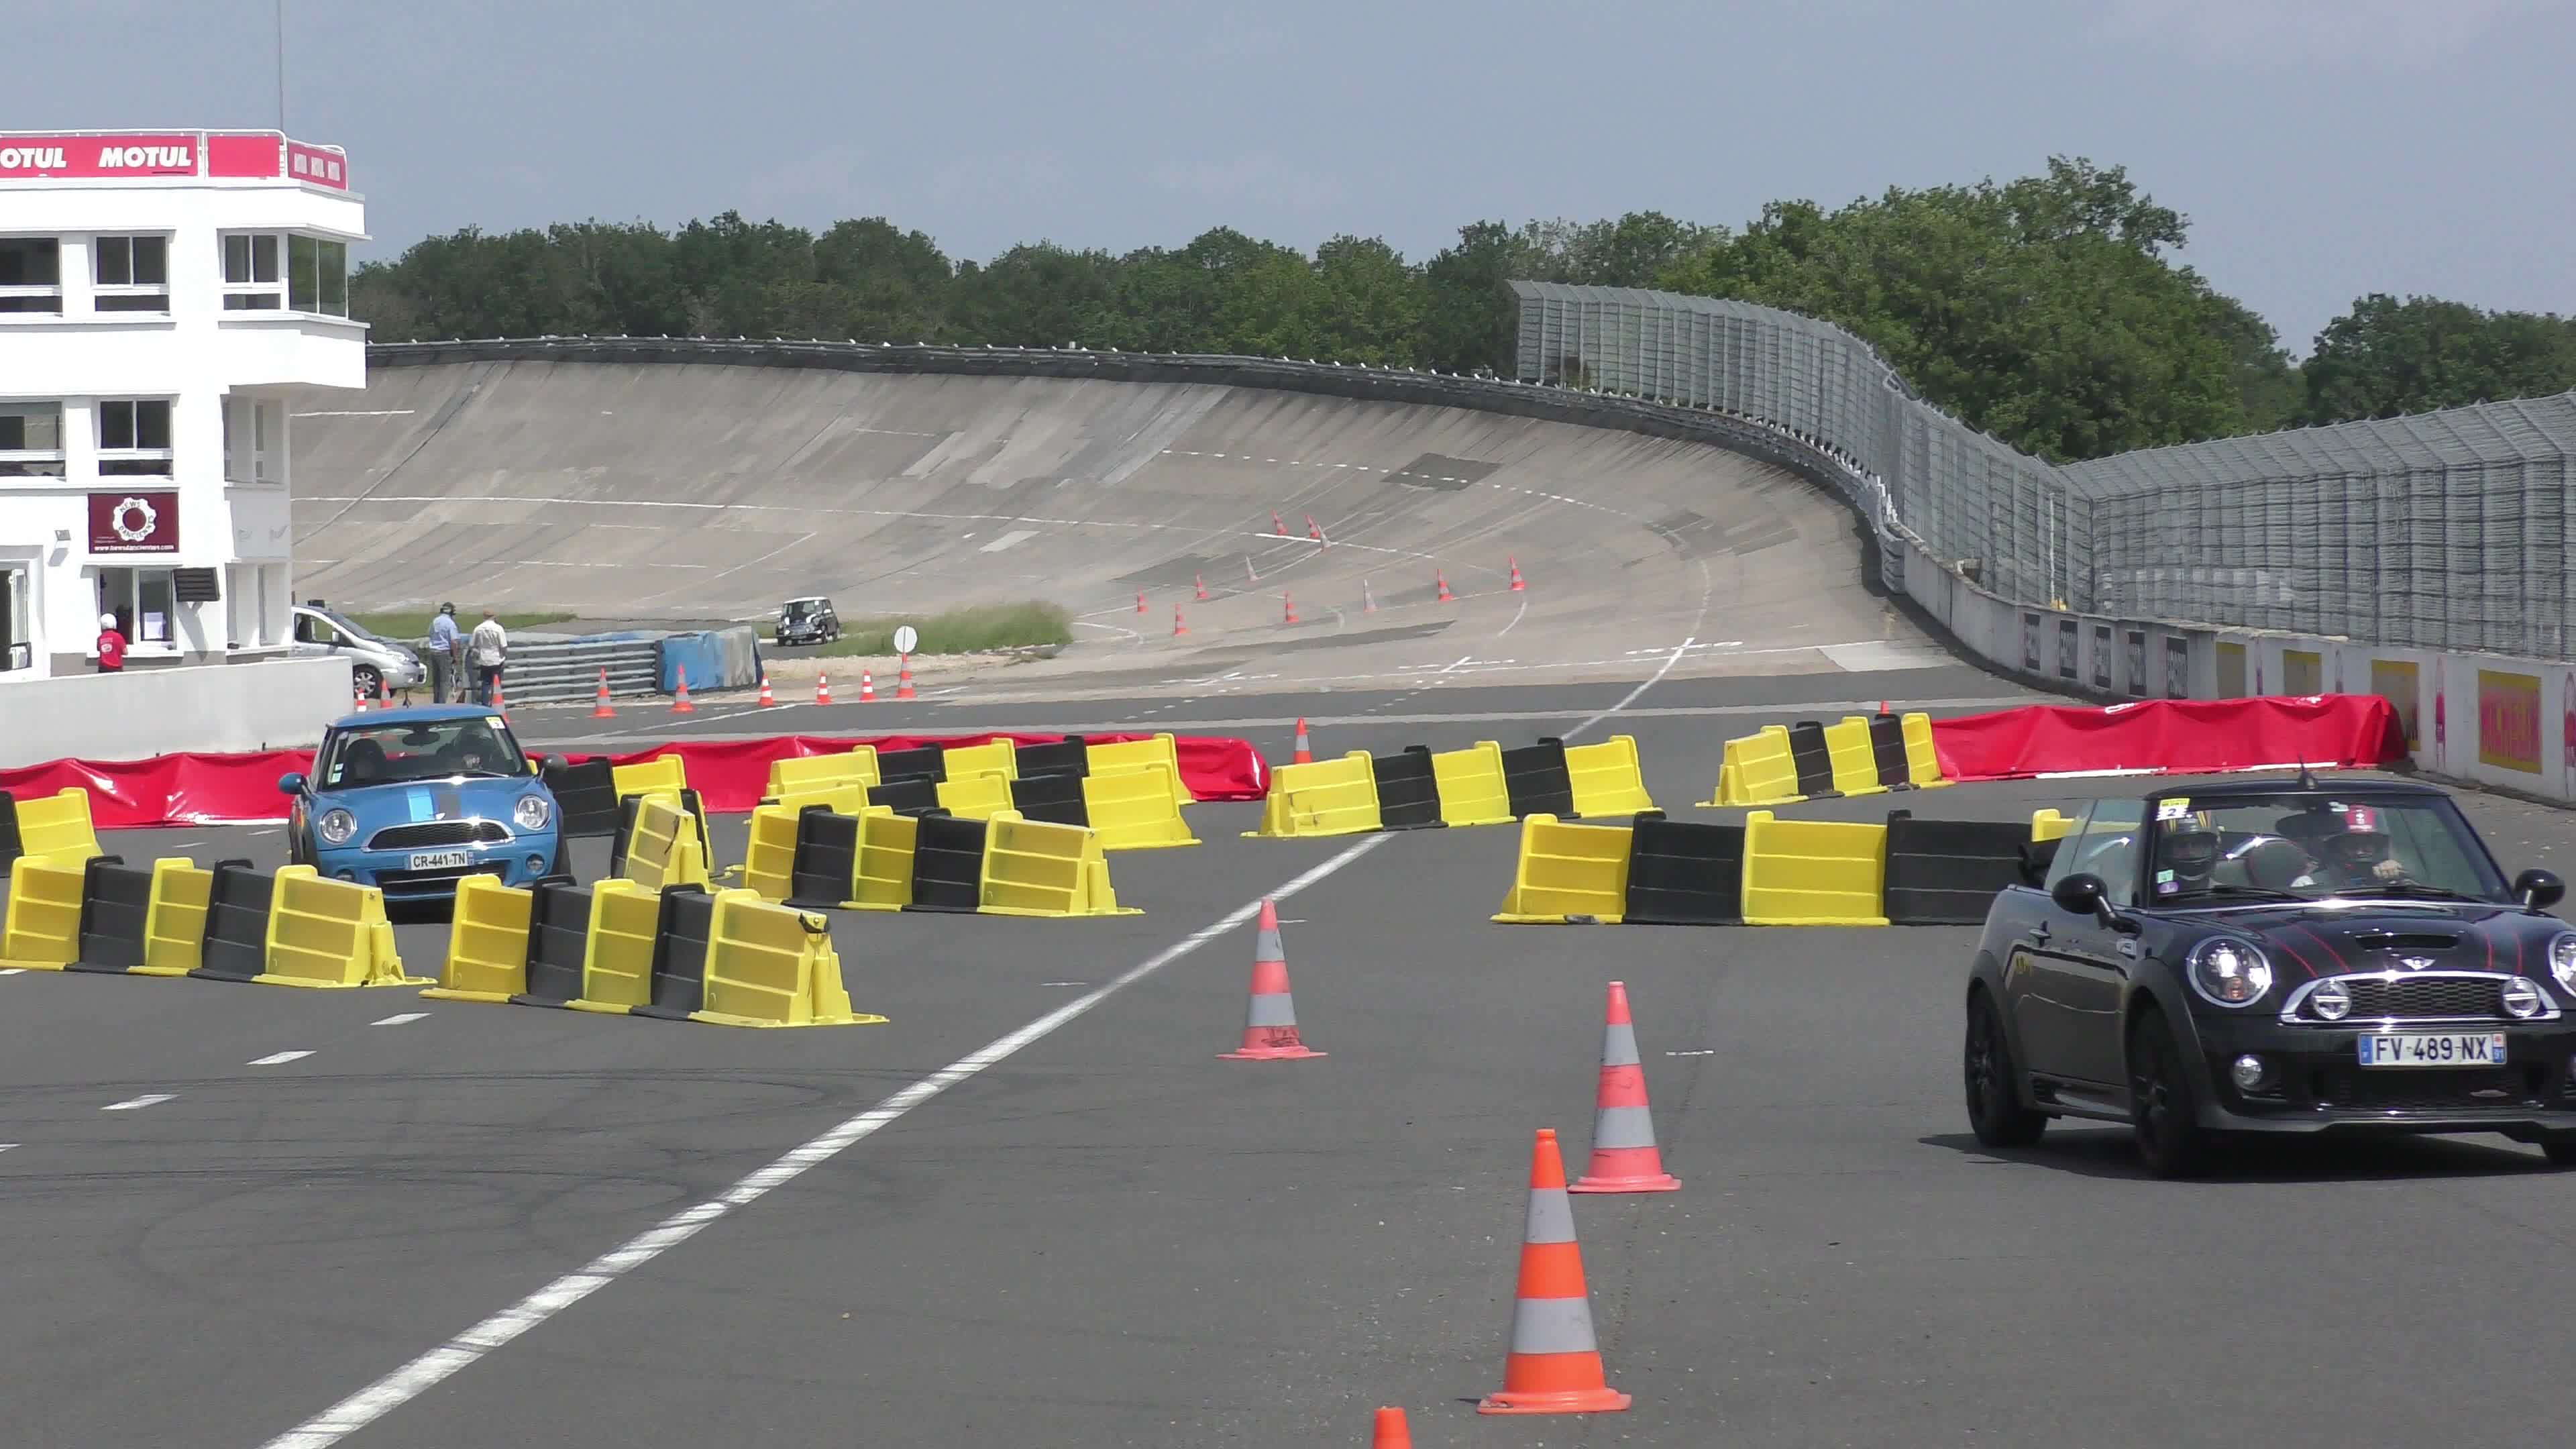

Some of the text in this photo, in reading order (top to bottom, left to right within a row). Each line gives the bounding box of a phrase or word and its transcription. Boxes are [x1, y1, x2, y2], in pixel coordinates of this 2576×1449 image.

[0, 148, 67, 168] OTUL
[98, 146, 193, 168] MOTUL
[119, 500, 141, 513] NEWS
[2375, 1036, 2488, 1061] FV-489-NX
